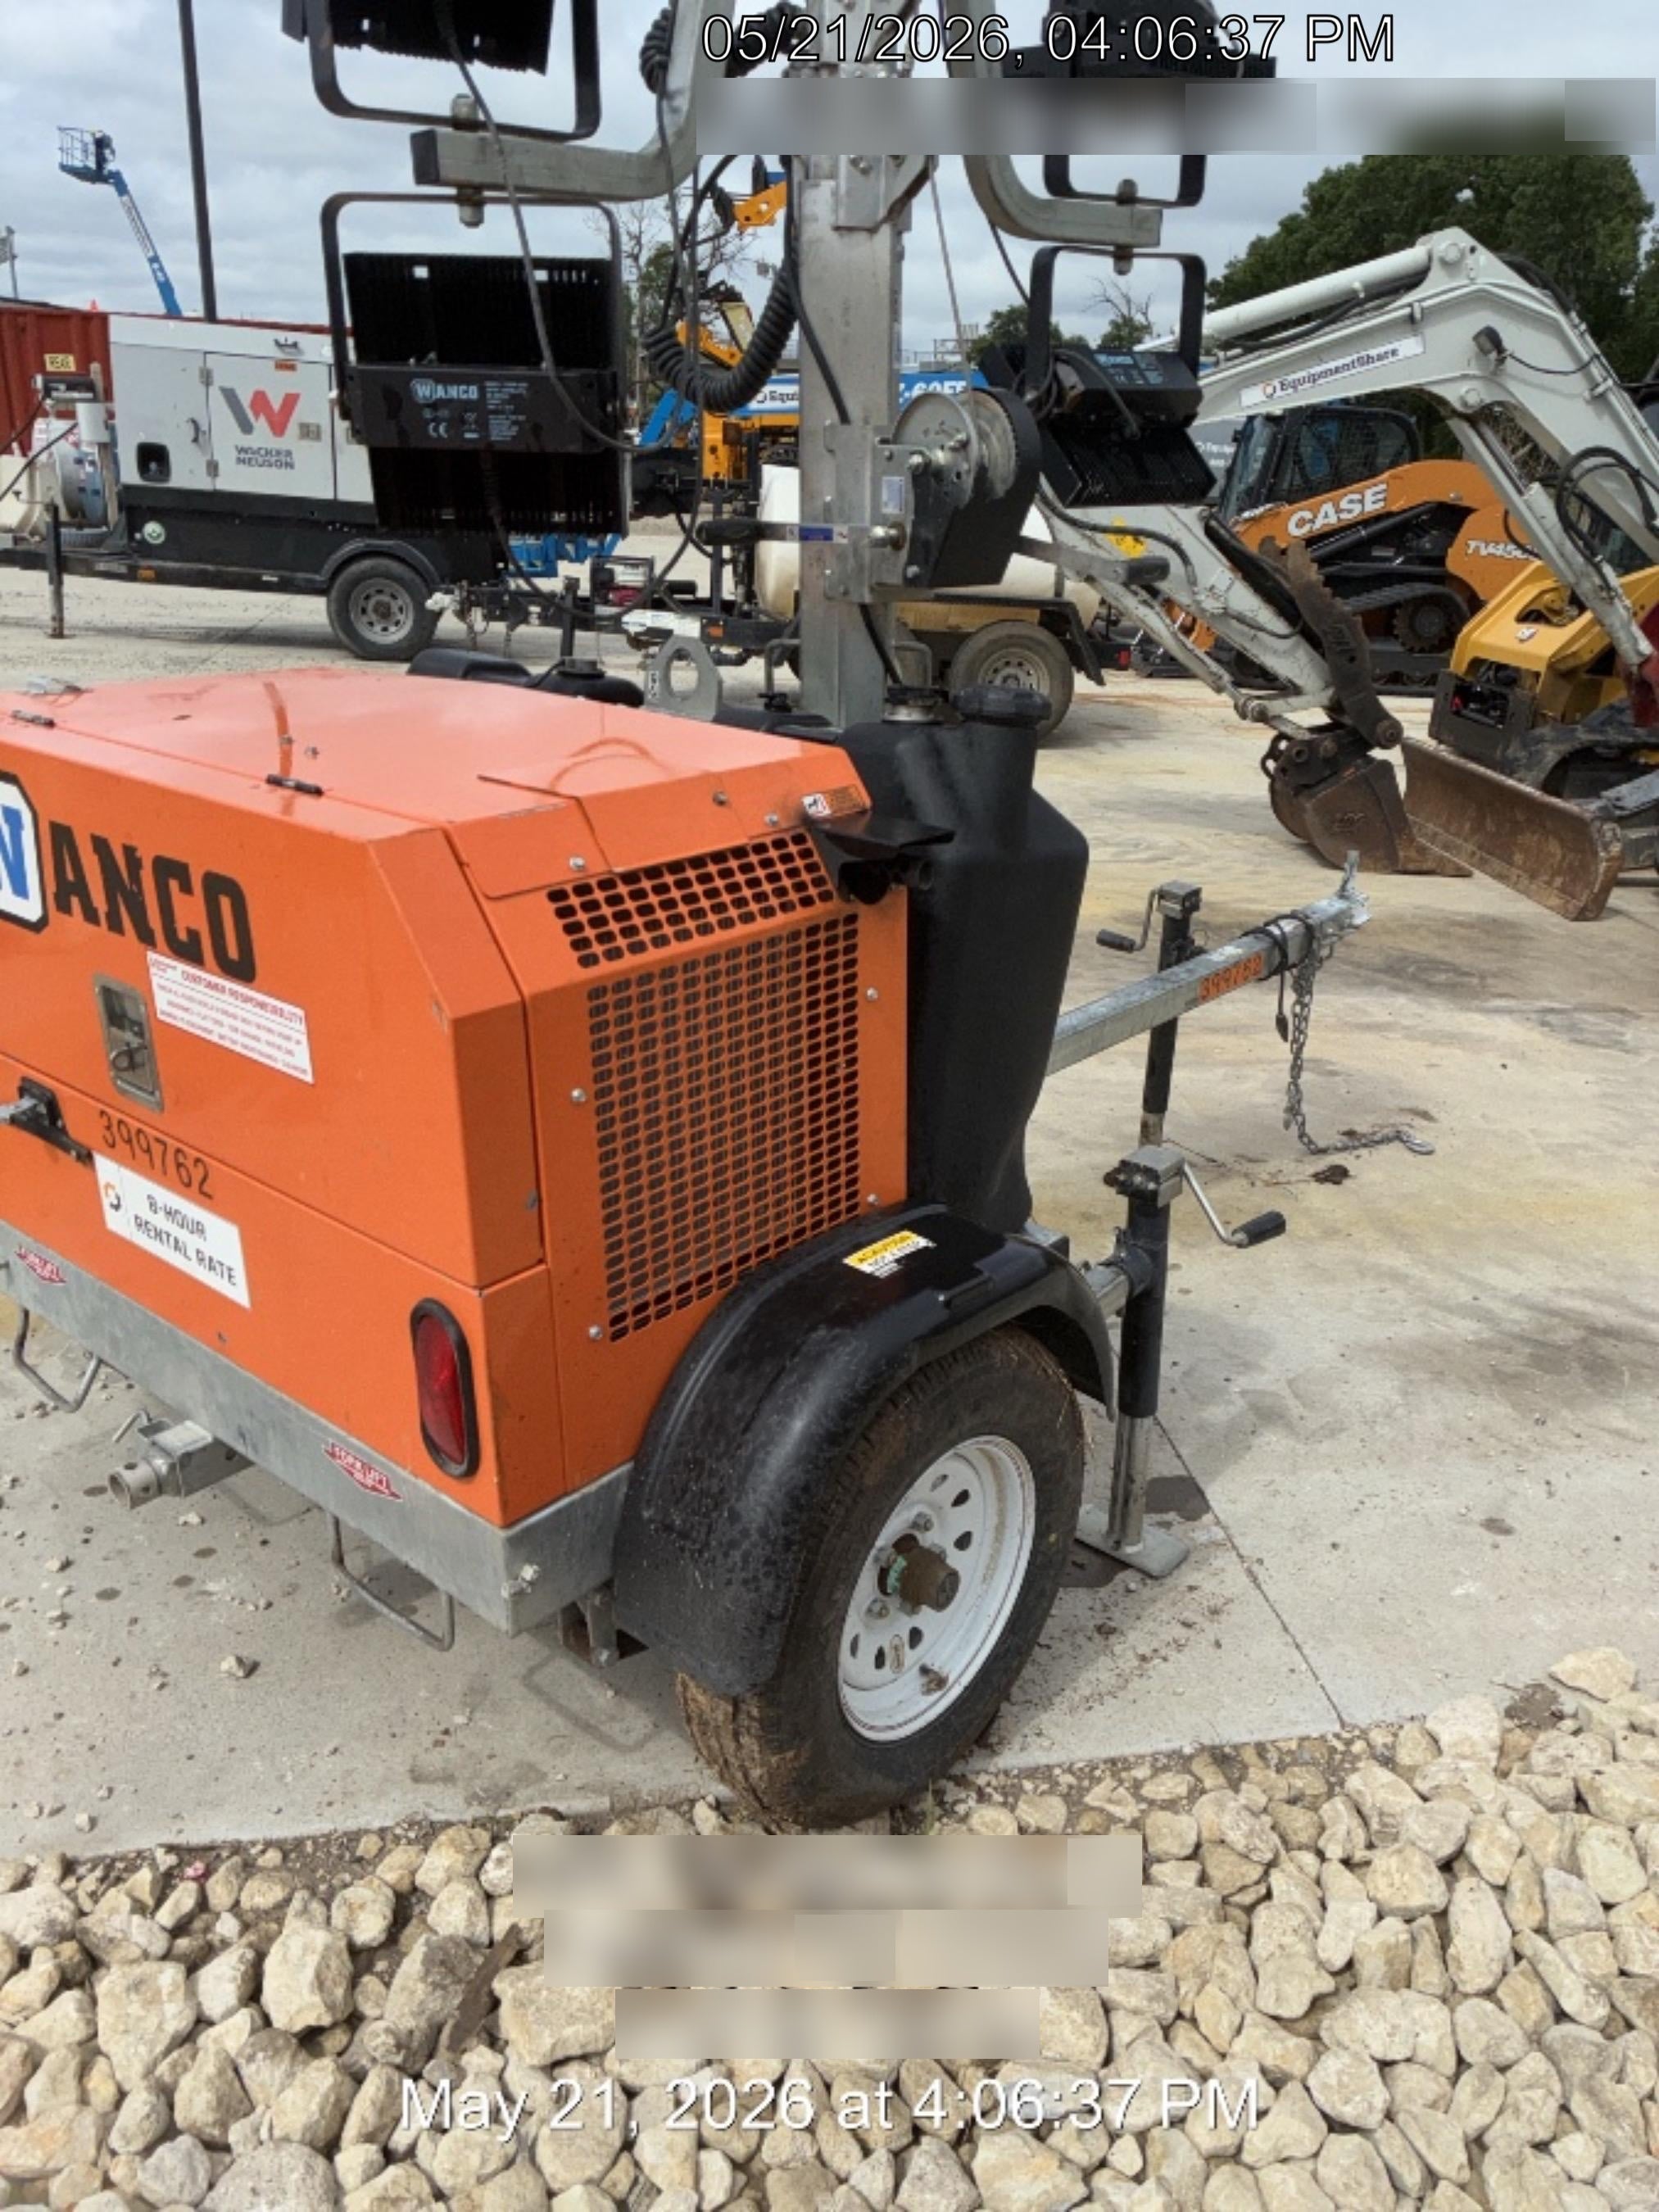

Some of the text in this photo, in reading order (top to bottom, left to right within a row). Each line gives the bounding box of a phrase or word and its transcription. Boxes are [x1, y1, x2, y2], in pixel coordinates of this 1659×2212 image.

[412, 380, 478, 401] WANCO
[1279, 347, 1399, 393] EquipmentShare
[235, 445, 293, 460] WACKER
[236, 456, 295, 470] NEUSON
[1287, 483, 1388, 537] CASE
[99, 1109, 214, 1200] 399762
[146, 1194, 207, 1242] 8-HOUR
[134, 1213, 237, 1286] RENTAL RATE
